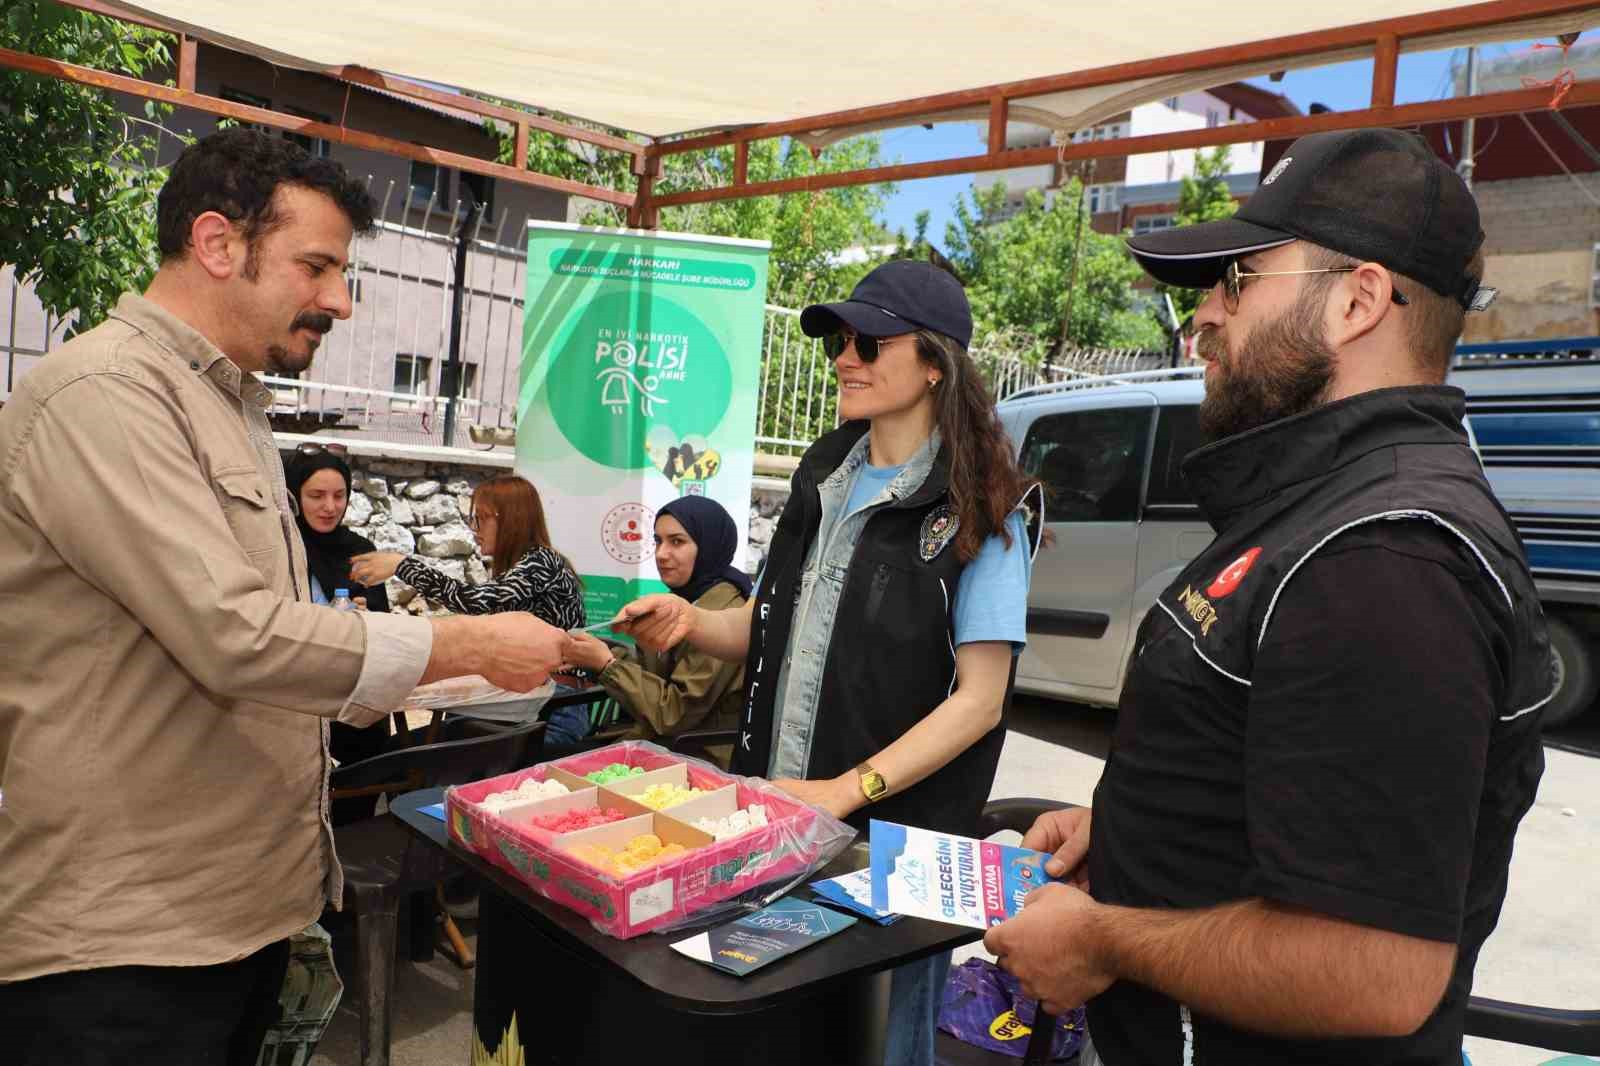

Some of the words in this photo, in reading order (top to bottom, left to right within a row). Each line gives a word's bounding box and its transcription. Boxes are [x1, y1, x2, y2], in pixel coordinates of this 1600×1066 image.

[598, 328, 611, 338] EN
[957, 841, 979, 908] UYUŞTURMA
[984, 864, 999, 911] UYUMA
